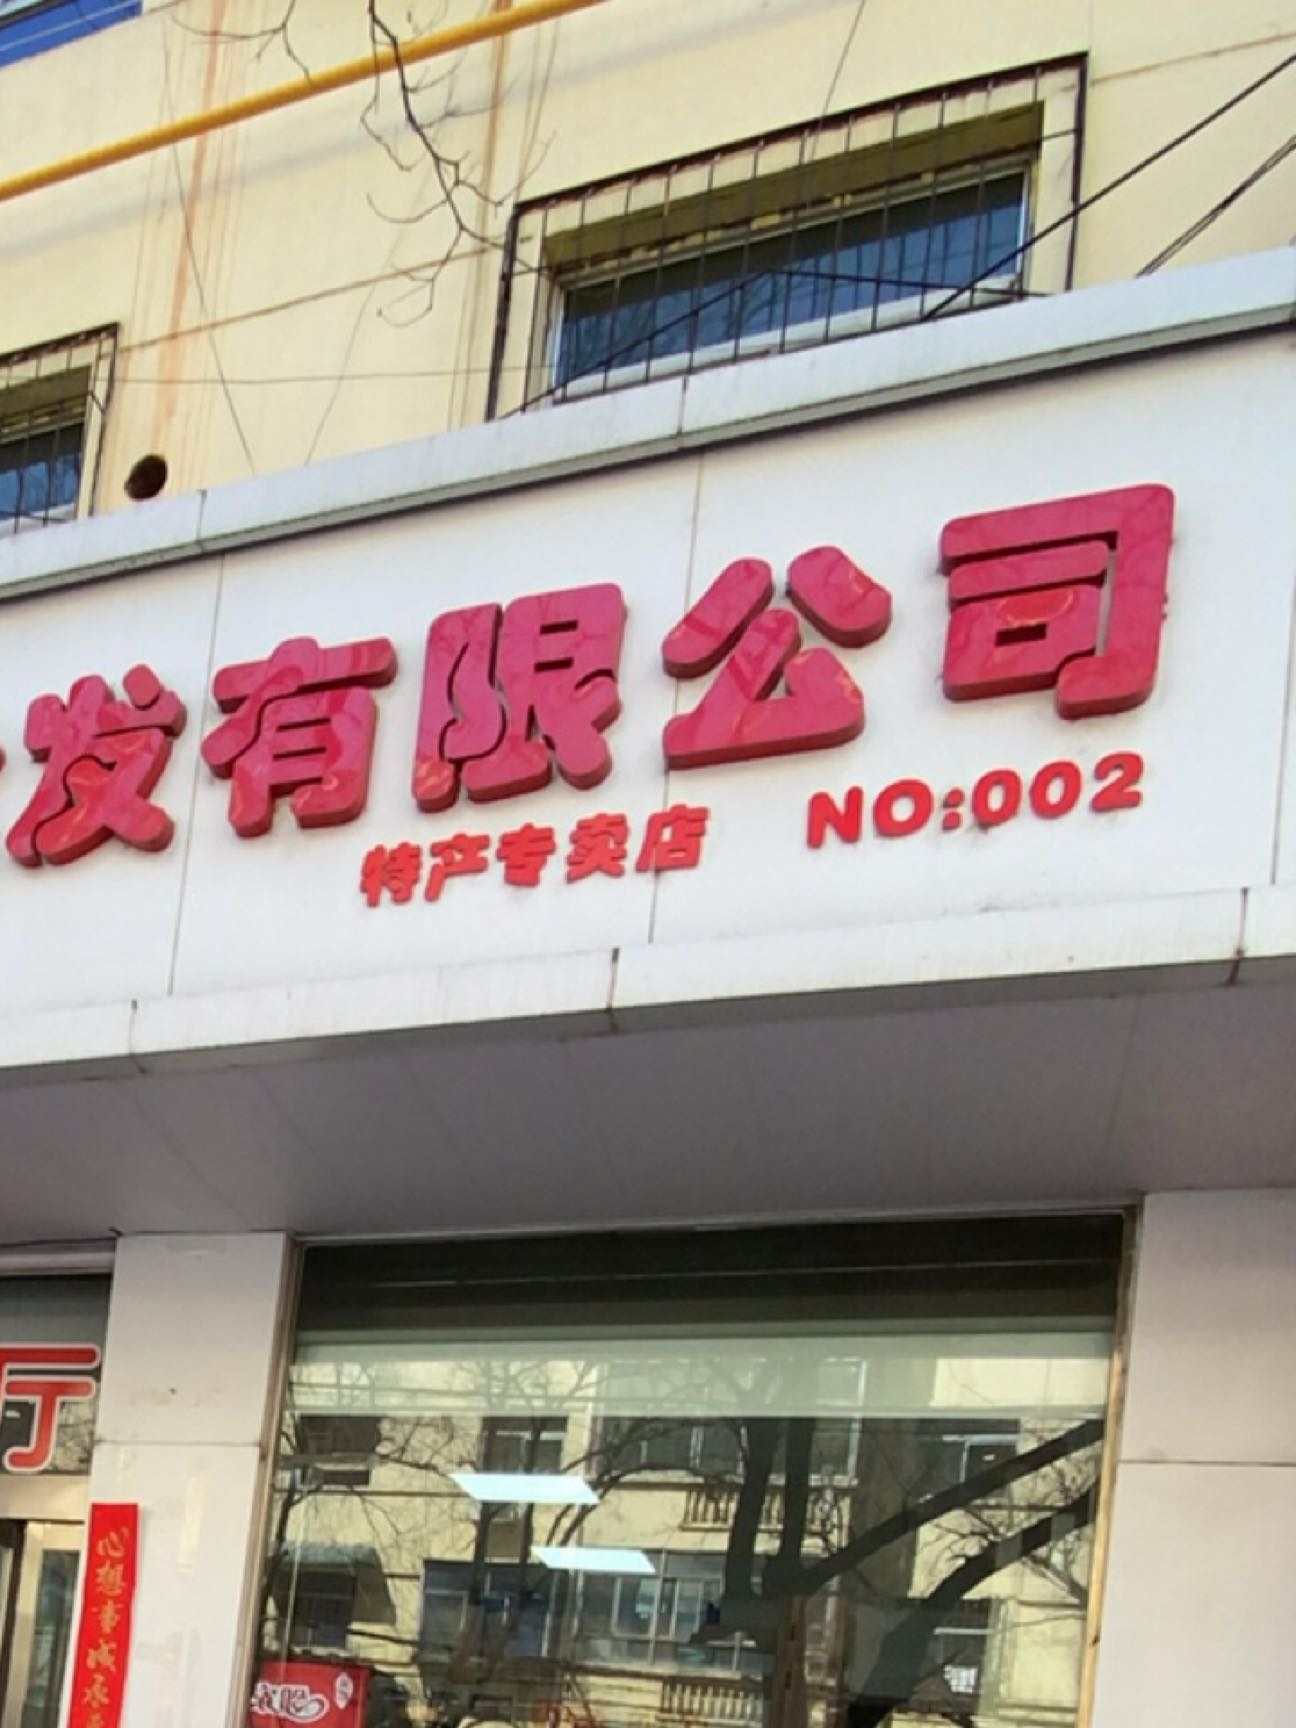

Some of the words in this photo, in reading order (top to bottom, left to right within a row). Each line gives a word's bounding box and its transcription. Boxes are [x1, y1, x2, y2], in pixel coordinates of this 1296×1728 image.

[806, 750, 1144, 851] NO:002
[359, 803, 710, 908] 特产专卖店
